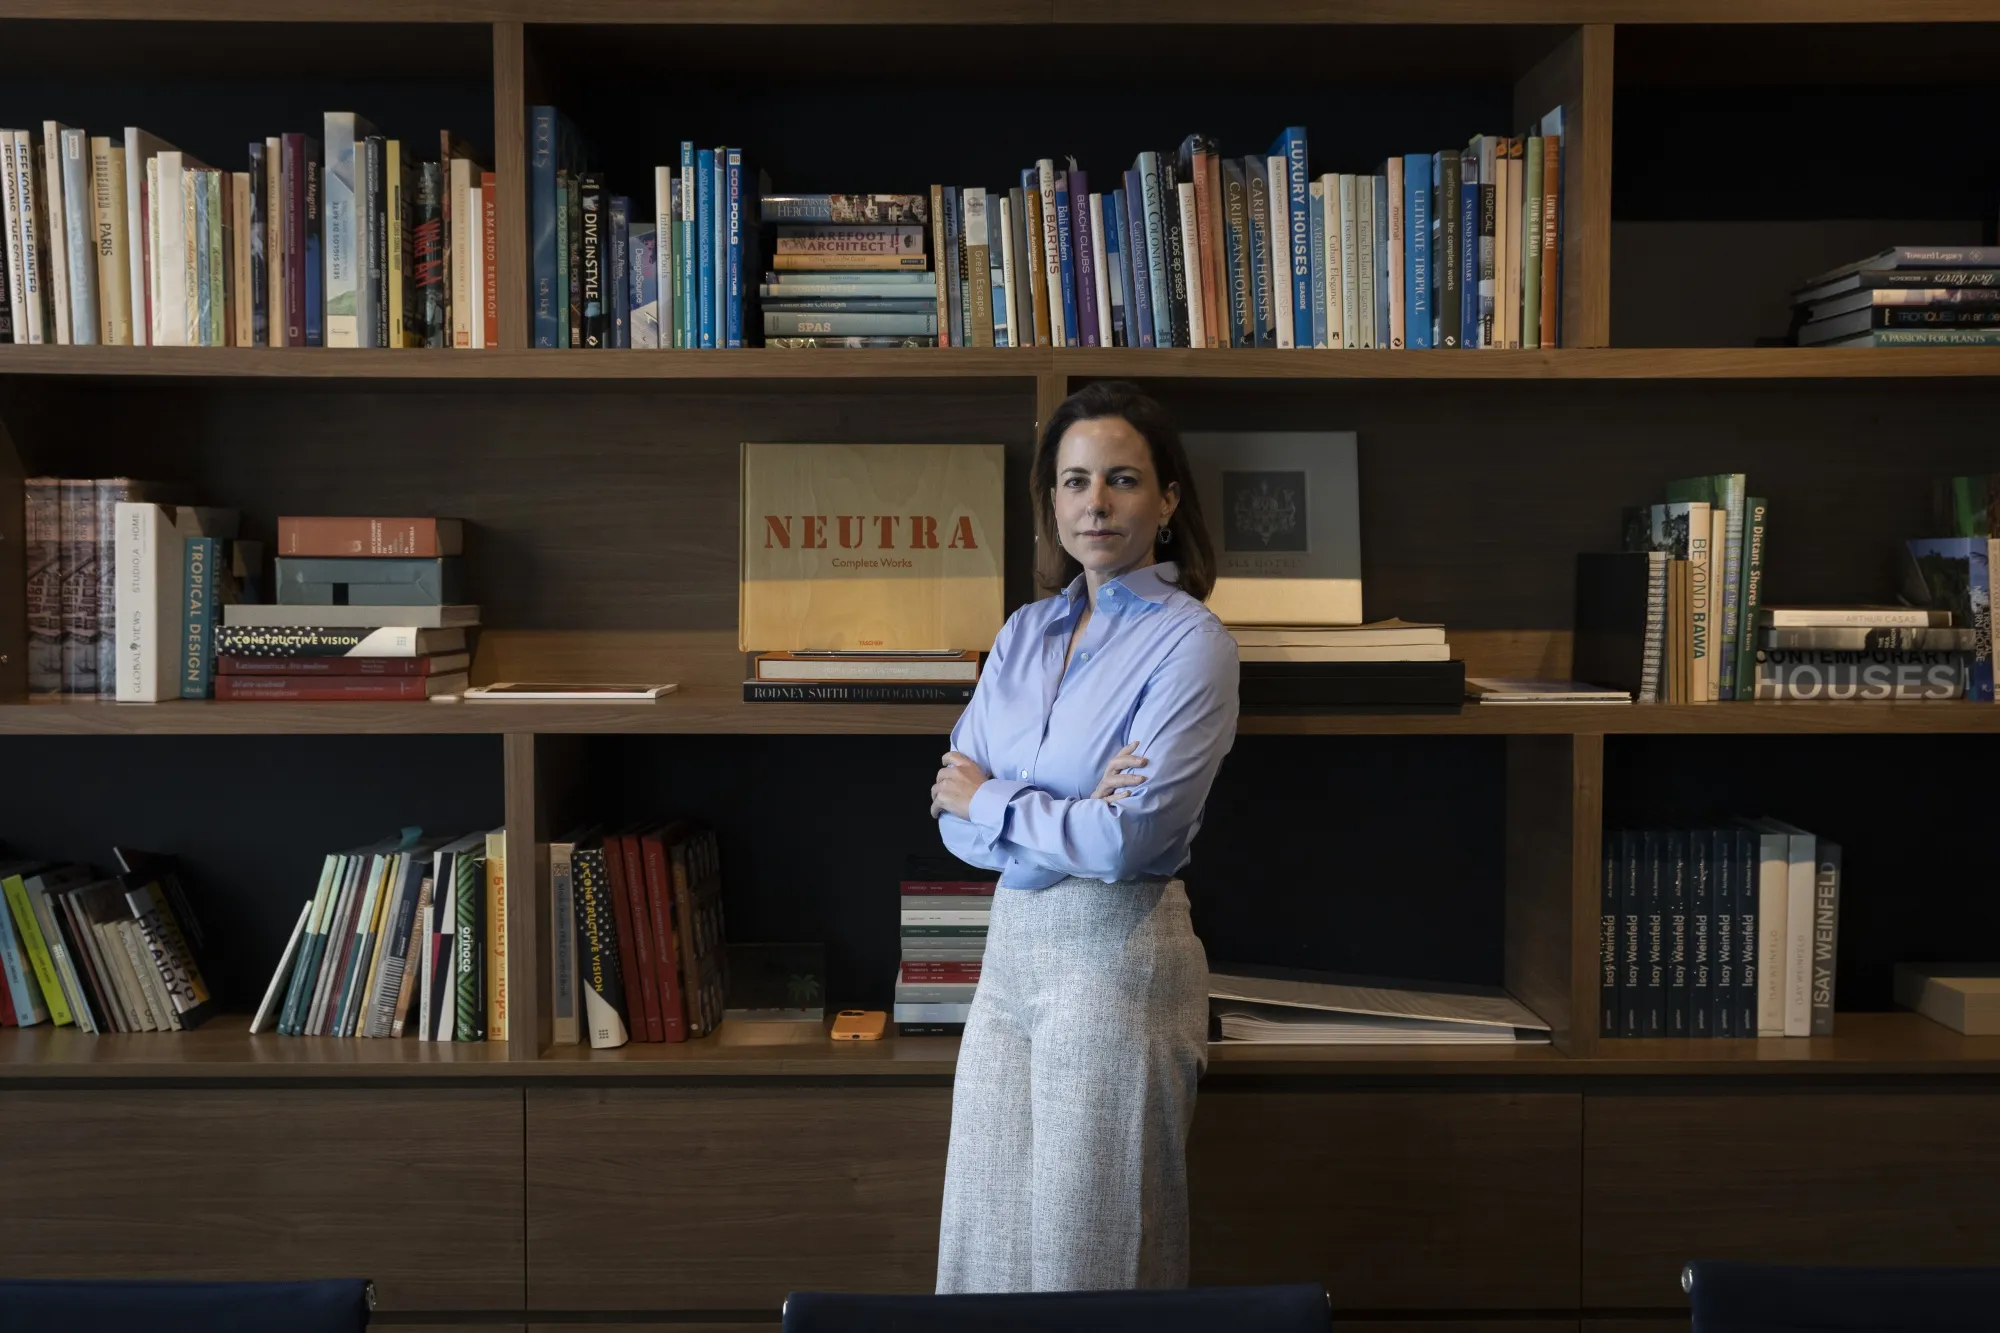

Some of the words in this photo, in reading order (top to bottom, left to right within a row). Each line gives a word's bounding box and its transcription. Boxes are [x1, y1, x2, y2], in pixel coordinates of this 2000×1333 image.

[535, 116, 551, 168] POOLS
[308, 162, 316, 181] René
[701, 168, 709, 202] NATURAL
[1291, 140, 1304, 204] LUXURY
[1446, 168, 1455, 198] geoffrey
[307, 184, 317, 219] Magritte
[684, 185, 692, 220] AMERICAN
[730, 168, 739, 245] COOLPOOLS
[1026, 194, 1034, 217] Tropical
[1044, 189, 1054, 209] ST.
[1195, 170, 1207, 211] Tropical
[1466, 198, 1472, 209] AN
[332, 202, 340, 219] ARTE
[701, 204, 709, 243] SWIMMING
[777, 205, 830, 217] HERCULES
[933, 195, 942, 221] Tropical
[1058, 206, 1067, 224] Bali
[1077, 194, 1087, 232] BEACH
[1184, 195, 1194, 227] ISLAND
[1229, 182, 1244, 263] CARIBBEAN
[1252, 178, 1267, 259] CARIBBEAN
[1393, 207, 1401, 240] minimal
[1414, 190, 1424, 252] ULTIMATE
[1447, 200, 1455, 219] bawa
[1485, 186, 1494, 233] TROPICAL
[100, 223, 112, 256] PARIS
[332, 221, 340, 232] DE
[413, 218, 441, 258] Wild
[486, 202, 495, 261] ARMANDO
[584, 213, 597, 244] DIVE
[659, 213, 670, 250] Infinity
[808, 232, 886, 241] BAREFOOT
[935, 222, 943, 260] Sustainable
[1171, 226, 1181, 256] sonho
[1186, 229, 1196, 248] LIFE
[1198, 213, 1209, 245] Living
[1345, 220, 1354, 250] French
[1361, 220, 1369, 250] French
[1447, 222, 1455, 233] the
[332, 235, 341, 261] SIGLOS
[586, 246, 594, 259] IN
[701, 244, 710, 268] POOLS
[807, 242, 886, 251] ARCHITECT
[1046, 215, 1059, 274] BARTHS
[1059, 227, 1069, 261] Modern
[1080, 236, 1090, 274] CLUBS
[1133, 221, 1145, 267] Caribbean
[1294, 211, 1307, 276] HOUSES
[1314, 217, 1324, 279] CARIBBEAN
[1329, 236, 1338, 264] Cuban
[1446, 235, 1455, 268] complete
[1904, 251, 1935, 259] Toward
[1935, 252, 1963, 261] Legacy
[332, 264, 341, 279] SEIS
[415, 260, 442, 288] Art
[634, 248, 644, 304] DesignSource
[660, 254, 671, 278] Pools
[975, 250, 984, 275] Great
[1173, 258, 1183, 271] de
[1346, 253, 1355, 279] Island
[1361, 253, 1370, 279] Island
[585, 260, 598, 299] STYLE
[937, 261, 945, 301] Architecture
[962, 282, 970, 310] TROPICAL
[1137, 270, 1148, 309] Elegance
[1175, 273, 1184, 300] casas
[1257, 263, 1269, 321] HOUSES
[1329, 267, 1338, 307] Elegance
[1415, 256, 1425, 315] TROPICAL
[976, 279, 986, 317] Escapes
[1235, 268, 1247, 325] HOUSES
[1315, 281, 1324, 314] STYLE
[1345, 282, 1355, 319] Elegance
[1361, 282, 1370, 319] Elegance
[798, 323, 831, 332] SPAS
[963, 312, 971, 336] REGIONS
[1889, 335, 1926, 343] PASSION
[1929, 335, 1948, 343] FOR
[1950, 335, 1986, 343] PLANTS
[1754, 506, 1765, 522] On
[764, 515, 978, 549] NEUTRA
[1751, 526, 1764, 567] Distant
[132, 559, 140, 593] STUDIO
[832, 558, 879, 569] Complete
[880, 558, 913, 568] Works
[1692, 538, 1707, 610] BEYOND
[190, 544, 204, 617] TROPICAL
[1728, 584, 1738, 593] of
[1748, 570, 1761, 606] Shores
[1728, 595, 1736, 609] the
[133, 611, 141, 642] VIEWS
[1692, 612, 1706, 659] BAWA
[1726, 611, 1736, 635] World
[1846, 615, 1883, 623] ARTHUR
[1884, 615, 1917, 623] CASAS
[187, 624, 202, 681] DESIGN
[224, 636, 232, 644] A
[235, 635, 318, 645] CONSTRUCTIVE
[321, 636, 359, 645] VISION
[1975, 630, 1985, 663] HOUSE
[133, 653, 141, 694] GLOBAL
[1756, 651, 1955, 665] CONTEMPORARY
[754, 687, 804, 699] RODNEY
[808, 687, 848, 699] SMITH
[852, 688, 946, 699] PHOTOGRAPHS
[1755, 665, 1956, 700] HOUSES
[1816, 862, 1835, 960] WEINFELD
[582, 871, 598, 952] CONSTRUCTIVE
[591, 955, 604, 992] VISION
[1603, 915, 1615, 962] Weinfeld
[1627, 915, 1638, 962] Weinfeld
[1649, 915, 1661, 962] Weinfeld
[1672, 915, 1684, 962] Weinfeld
[1696, 915, 1707, 962] Weinfeld
[1719, 915, 1730, 962] Weinfeld
[1742, 915, 1753, 962] Weinfeld
[462, 927, 473, 972] orinoco
[1603, 965, 1615, 987] Isay
[1627, 965, 1638, 987] Isay
[1649, 965, 1661, 987] Isay
[1672, 965, 1684, 987] Isay
[1696, 965, 1707, 987] Isay
[1719, 965, 1730, 987] Isay
[1742, 965, 1754, 987] Isay
[1814, 966, 1830, 1008] ISAY
